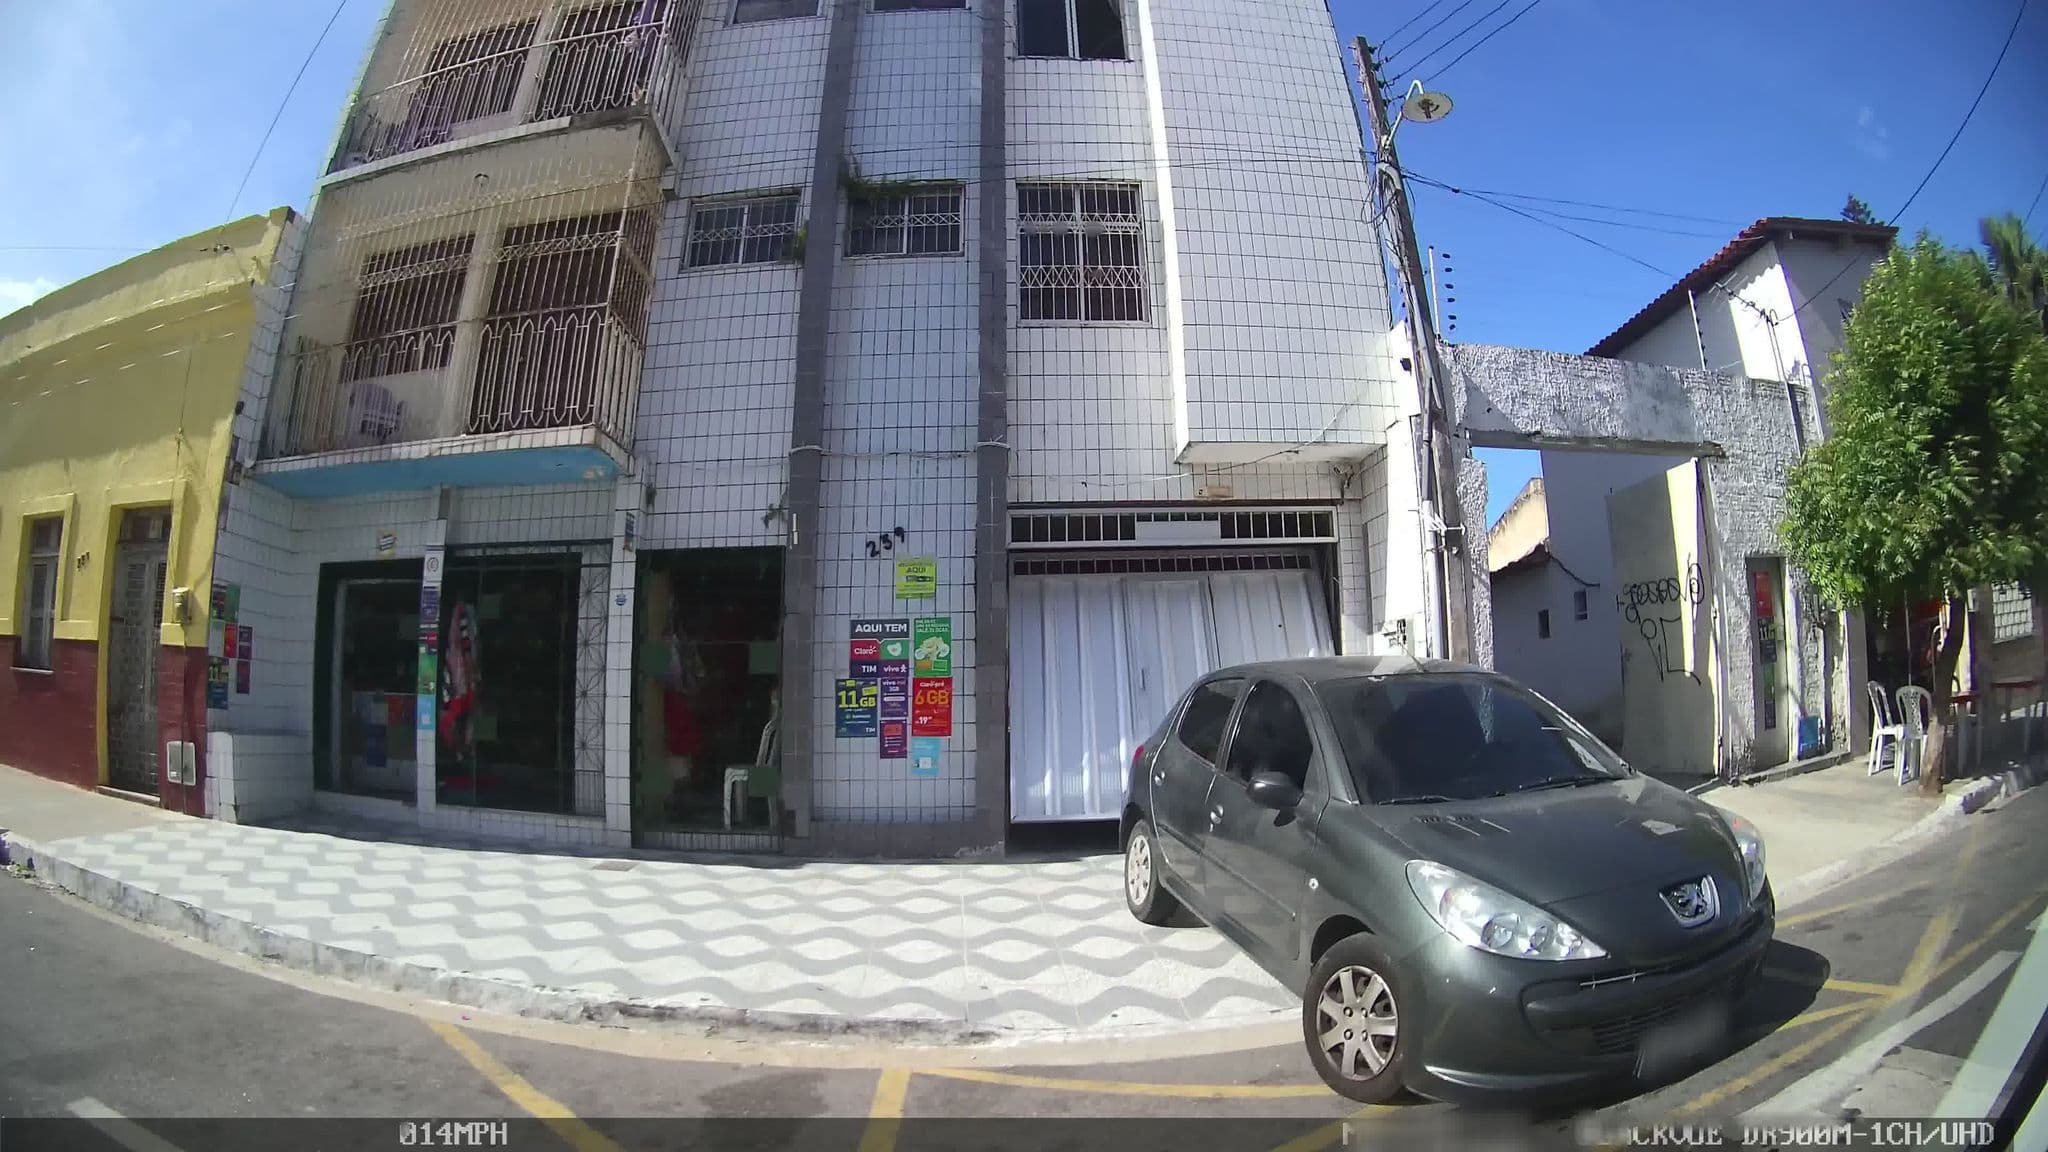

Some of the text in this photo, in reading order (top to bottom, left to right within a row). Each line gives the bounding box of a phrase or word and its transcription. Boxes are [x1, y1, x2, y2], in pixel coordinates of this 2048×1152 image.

[855, 624, 882, 632] AQUI
[885, 624, 907, 632] TEM
[854, 647, 874, 655] Claro
[862, 665, 877, 673] TIM
[883, 665, 900, 673] vivo
